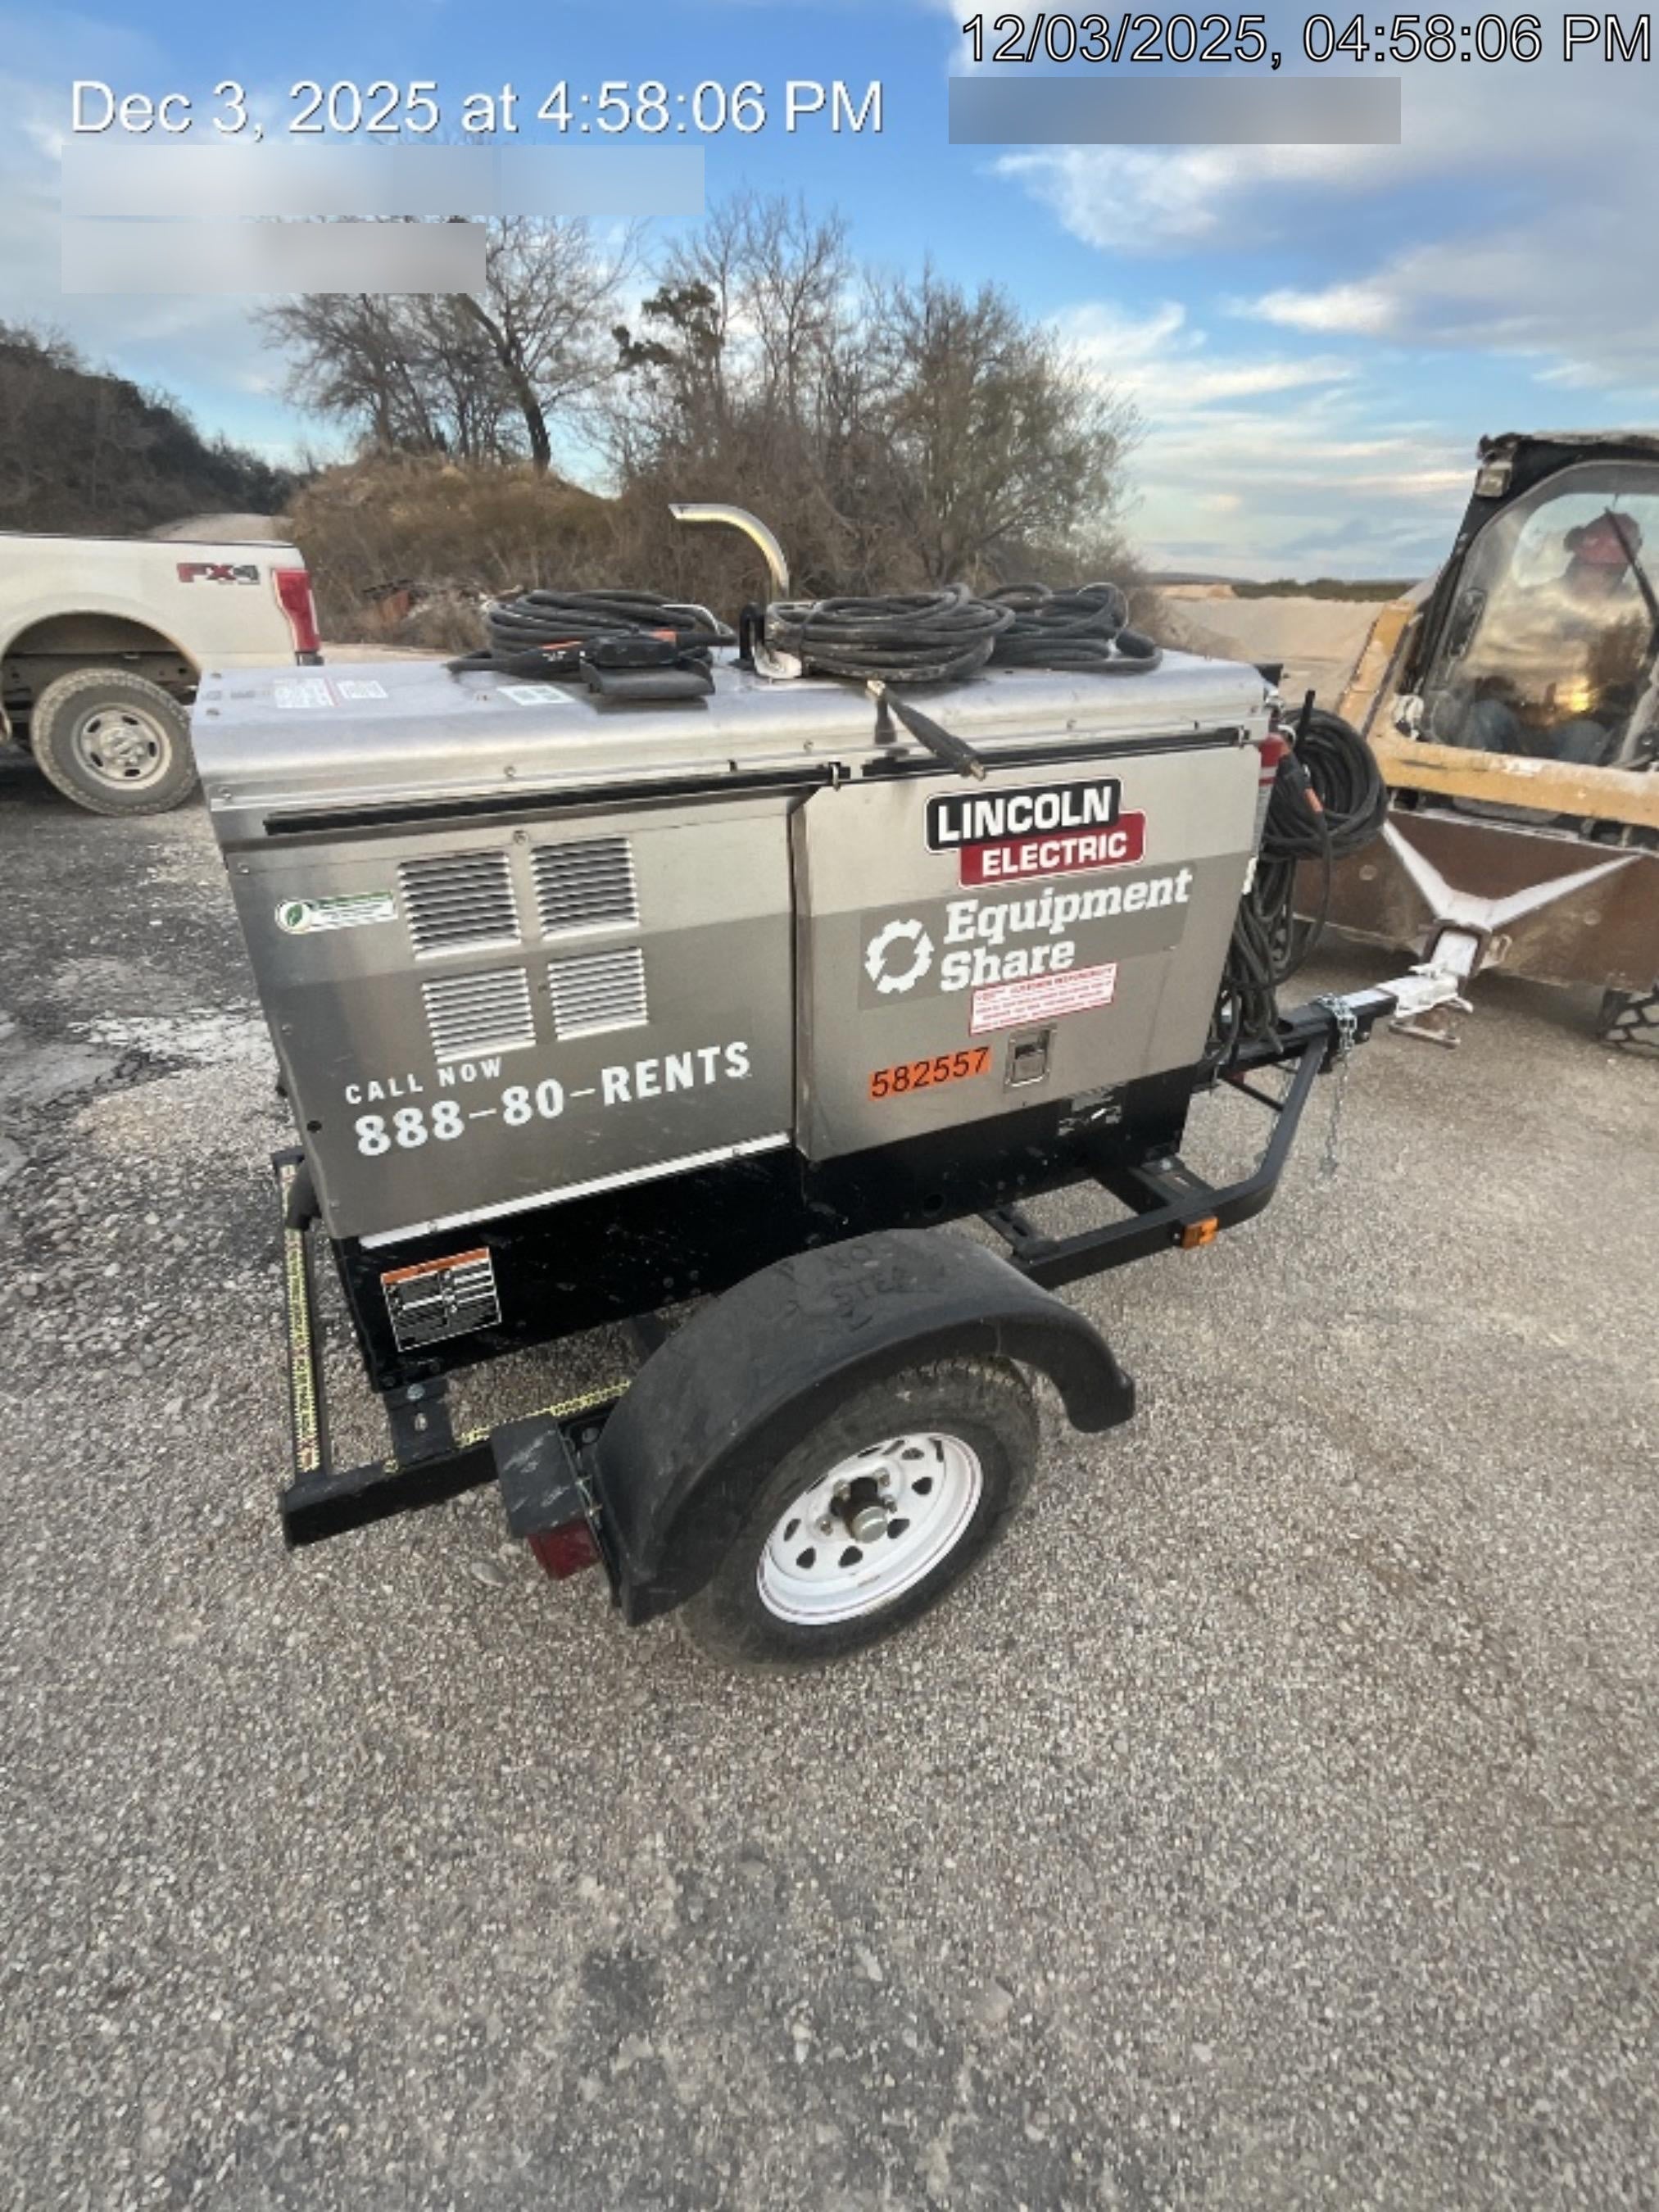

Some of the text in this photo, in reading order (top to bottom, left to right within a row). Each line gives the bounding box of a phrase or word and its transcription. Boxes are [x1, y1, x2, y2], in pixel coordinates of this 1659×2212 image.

[177, 563, 260, 585] FX4
[938, 786, 1112, 842] LINCOLN
[982, 832, 1127, 877] ELECTRIC
[943, 867, 1193, 945] Equipment
[940, 941, 1076, 991] Share
[345, 1057, 502, 1104] CALL NOW
[871, 1046, 989, 1098] 582557
[355, 1041, 751, 1156] 888-80-RENTS
